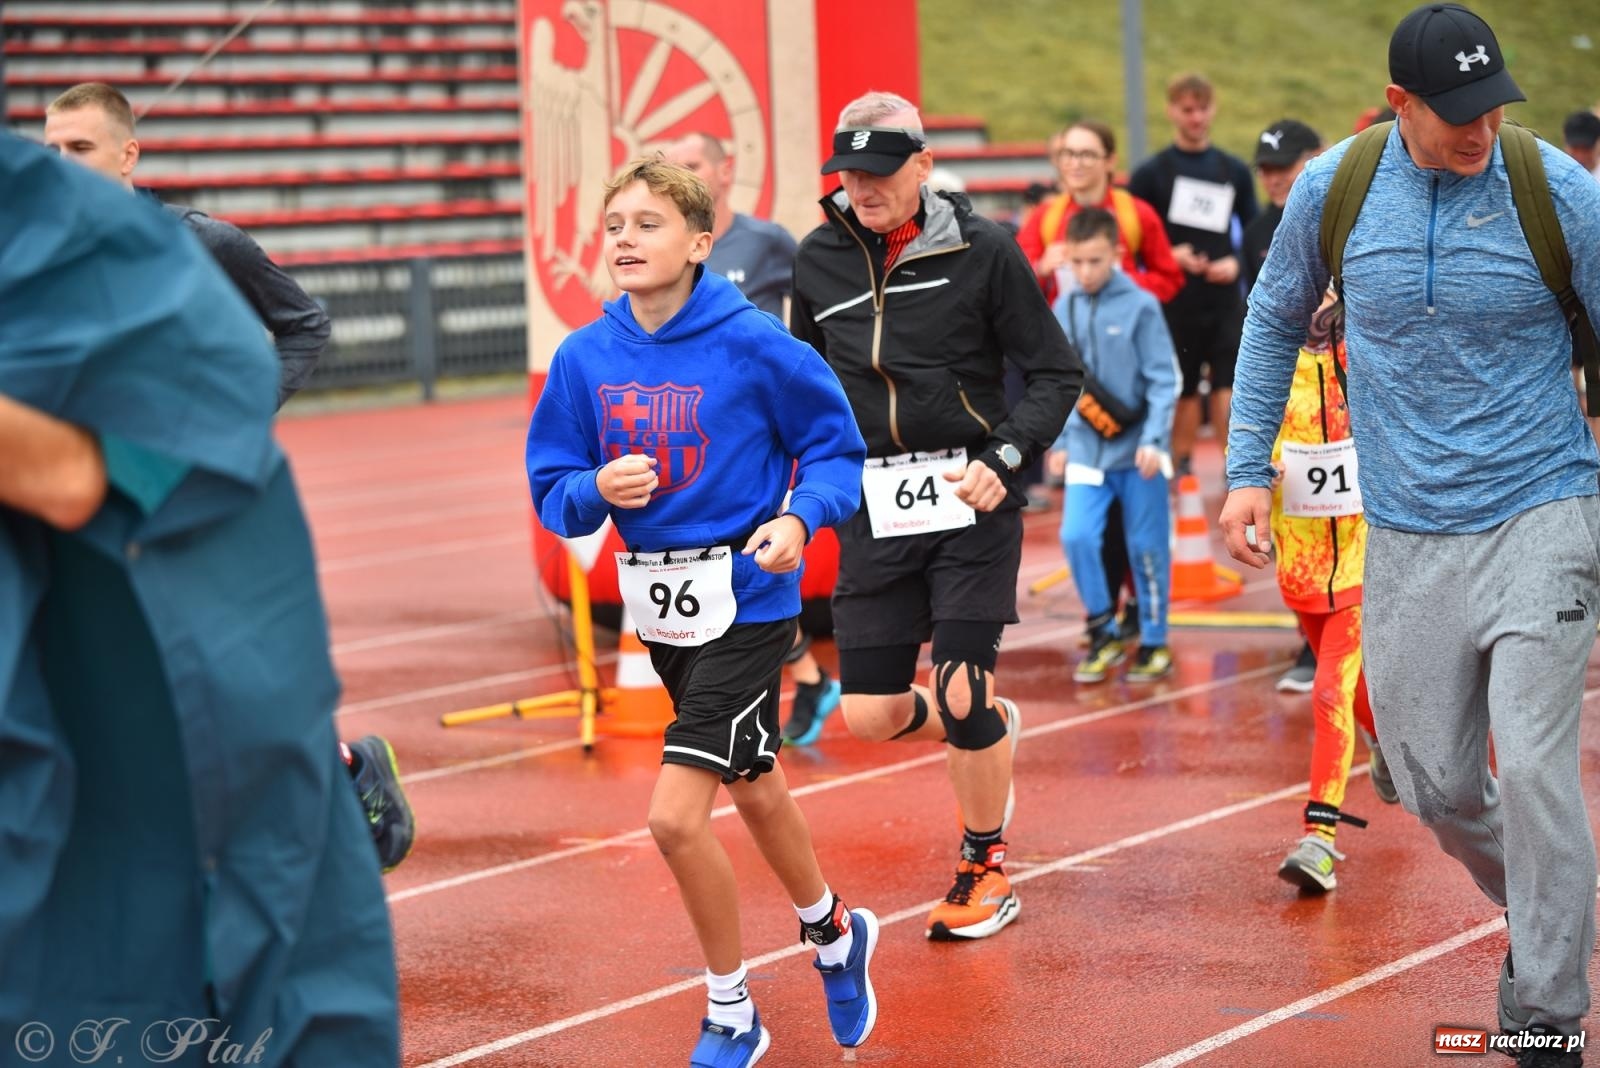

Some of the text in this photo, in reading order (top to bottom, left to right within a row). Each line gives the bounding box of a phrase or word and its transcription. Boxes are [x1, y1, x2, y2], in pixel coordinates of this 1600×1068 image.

[895, 476, 940, 510] 64
[1307, 464, 1351, 495] 91
[649, 579, 701, 619] 96
[1557, 610, 1584, 623] PUMA
[656, 628, 696, 639] Racibórz
